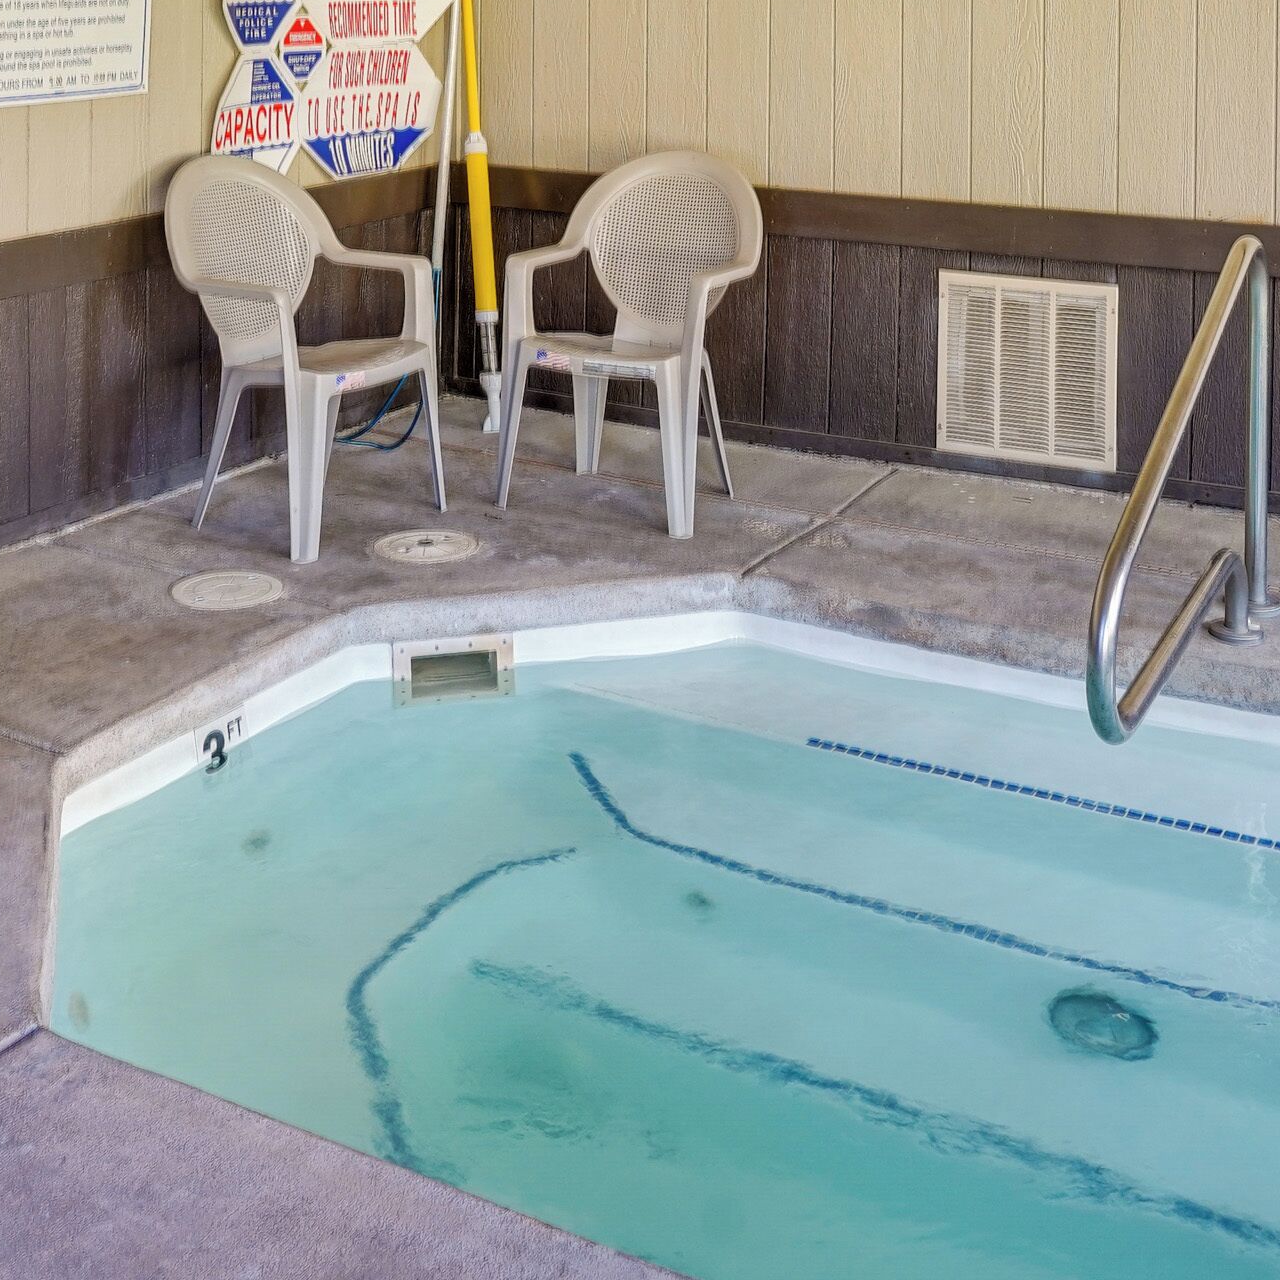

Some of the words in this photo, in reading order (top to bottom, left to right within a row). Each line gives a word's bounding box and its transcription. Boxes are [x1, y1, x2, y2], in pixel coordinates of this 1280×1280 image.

[6, 18, 24, 27] under
[25, 18, 36, 26] the
[37, 19, 49, 28] age
[57, 16, 68, 25] five
[69, 18, 86, 27] years
[97, 15, 125, 26] prohibited
[235, 6, 278, 17] MEDICAL
[239, 18, 273, 28] POLICE
[329, 1, 389, 40] RECOMMENDED
[392, 0, 417, 37] TIME
[245, 28, 266, 39] FIRE
[21, 77, 43, 89] FROM
[67, 75, 76, 86] AM
[81, 74, 89, 85] TO
[106, 72, 118, 83] PM
[119, 71, 138, 82] DAILY
[329, 52, 343, 90] FOR
[345, 51, 366, 88] SUCH
[367, 49, 411, 86] CHILDREN
[252, 92, 282, 102] OPERATOR
[215, 103, 295, 150] CAPACITY
[308, 97, 321, 137] TO
[326, 95, 345, 133] USE
[352, 93, 369, 130] THE
[375, 92, 398, 129] SPA
[405, 91, 421, 126] IS
[329, 136, 346, 176] 10
[347, 132, 395, 171] MINUTES
[203, 729, 228, 774] 3
[227, 716, 242, 741] FT
